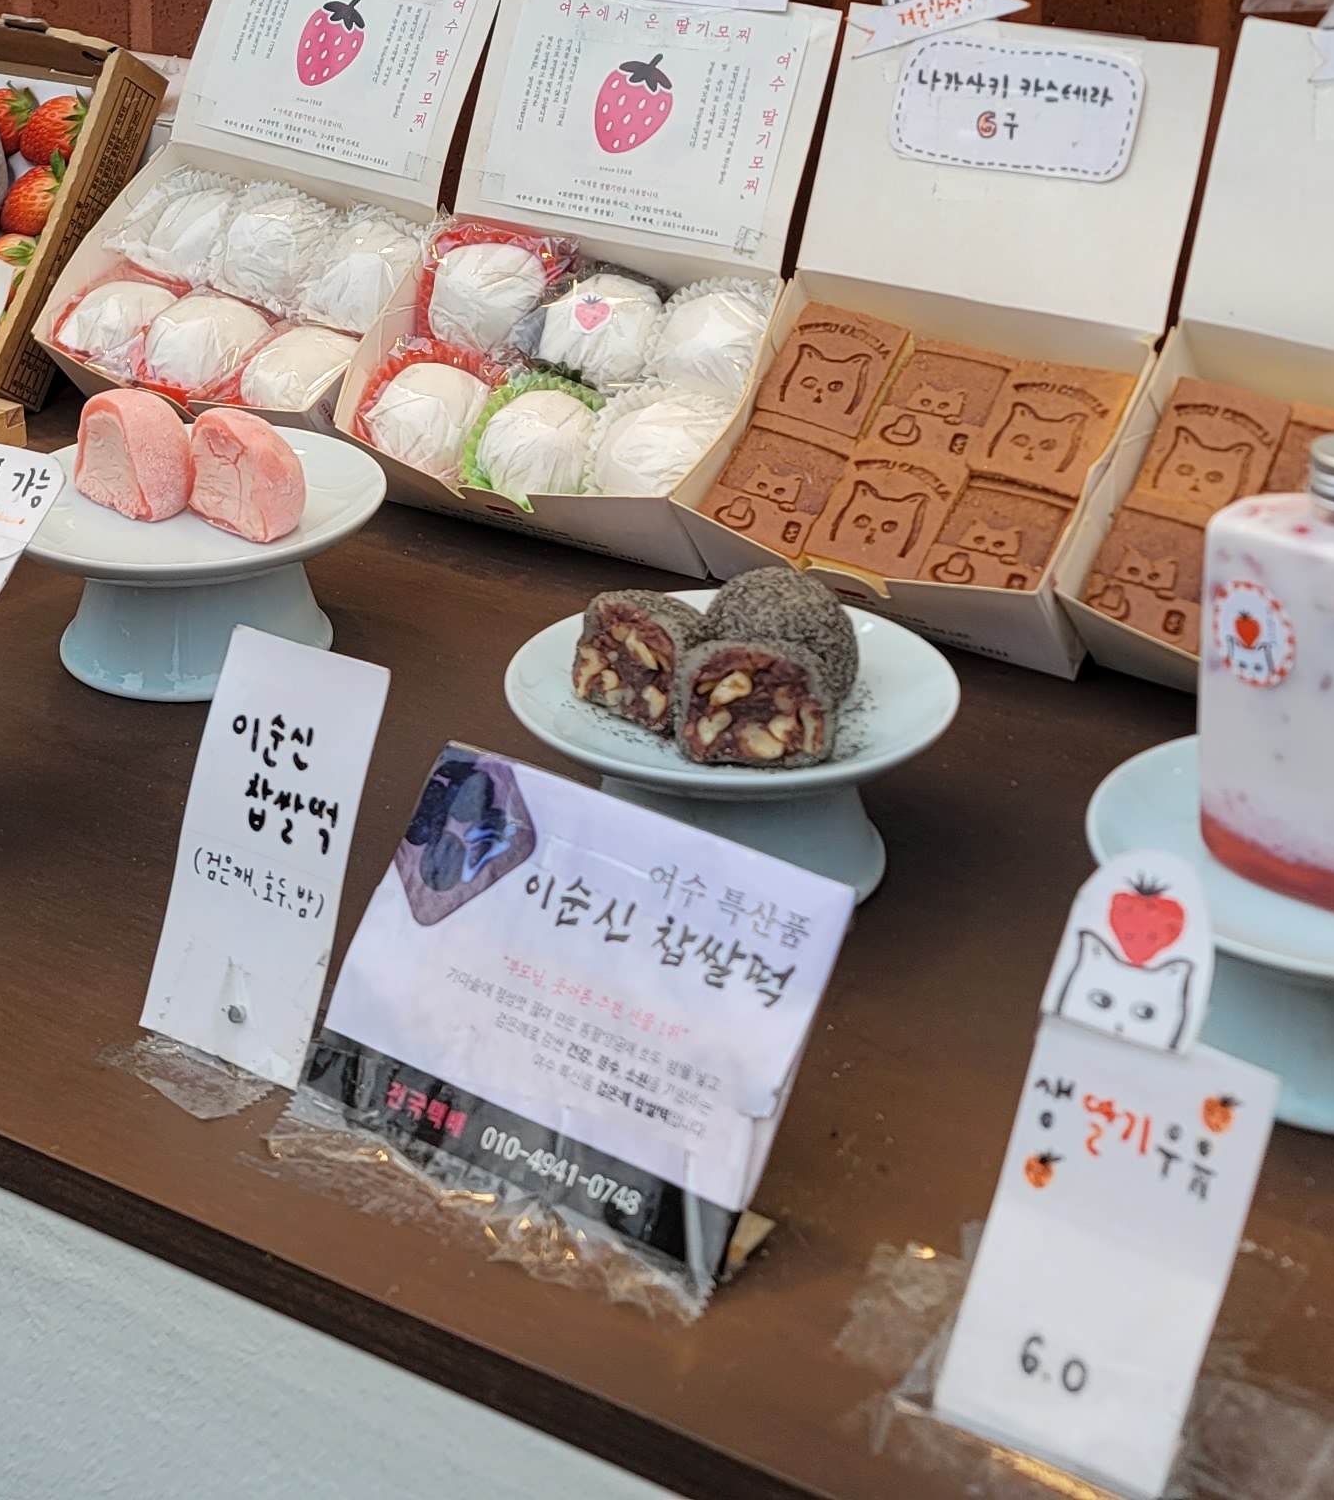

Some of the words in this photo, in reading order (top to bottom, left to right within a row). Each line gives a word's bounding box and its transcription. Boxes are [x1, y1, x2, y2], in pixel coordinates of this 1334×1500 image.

[559, 0, 630, 25] 여수에서
[644, 13, 660, 30] 온
[676, 17, 753, 45] 딸기모찌
[917, 68, 1008, 100] 나가사키
[1019, 76, 1113, 107] 카스테라
[976, 110, 1020, 140] 6구
[11, 467, 51, 509] 가능
[232, 714, 315, 771] 이순신
[244, 772, 339, 855] 찹쌀떡
[648, 863, 708, 908] 여수
[717, 885, 811, 950] 특산품
[525, 872, 636, 944] 이순신
[651, 917, 797, 1007] 찹쌀떡
[384, 1079, 468, 1139] 전국택배
[479, 1125, 644, 1217] 010-4941-0748
[1020, 1334, 1089, 1393] 6.0
